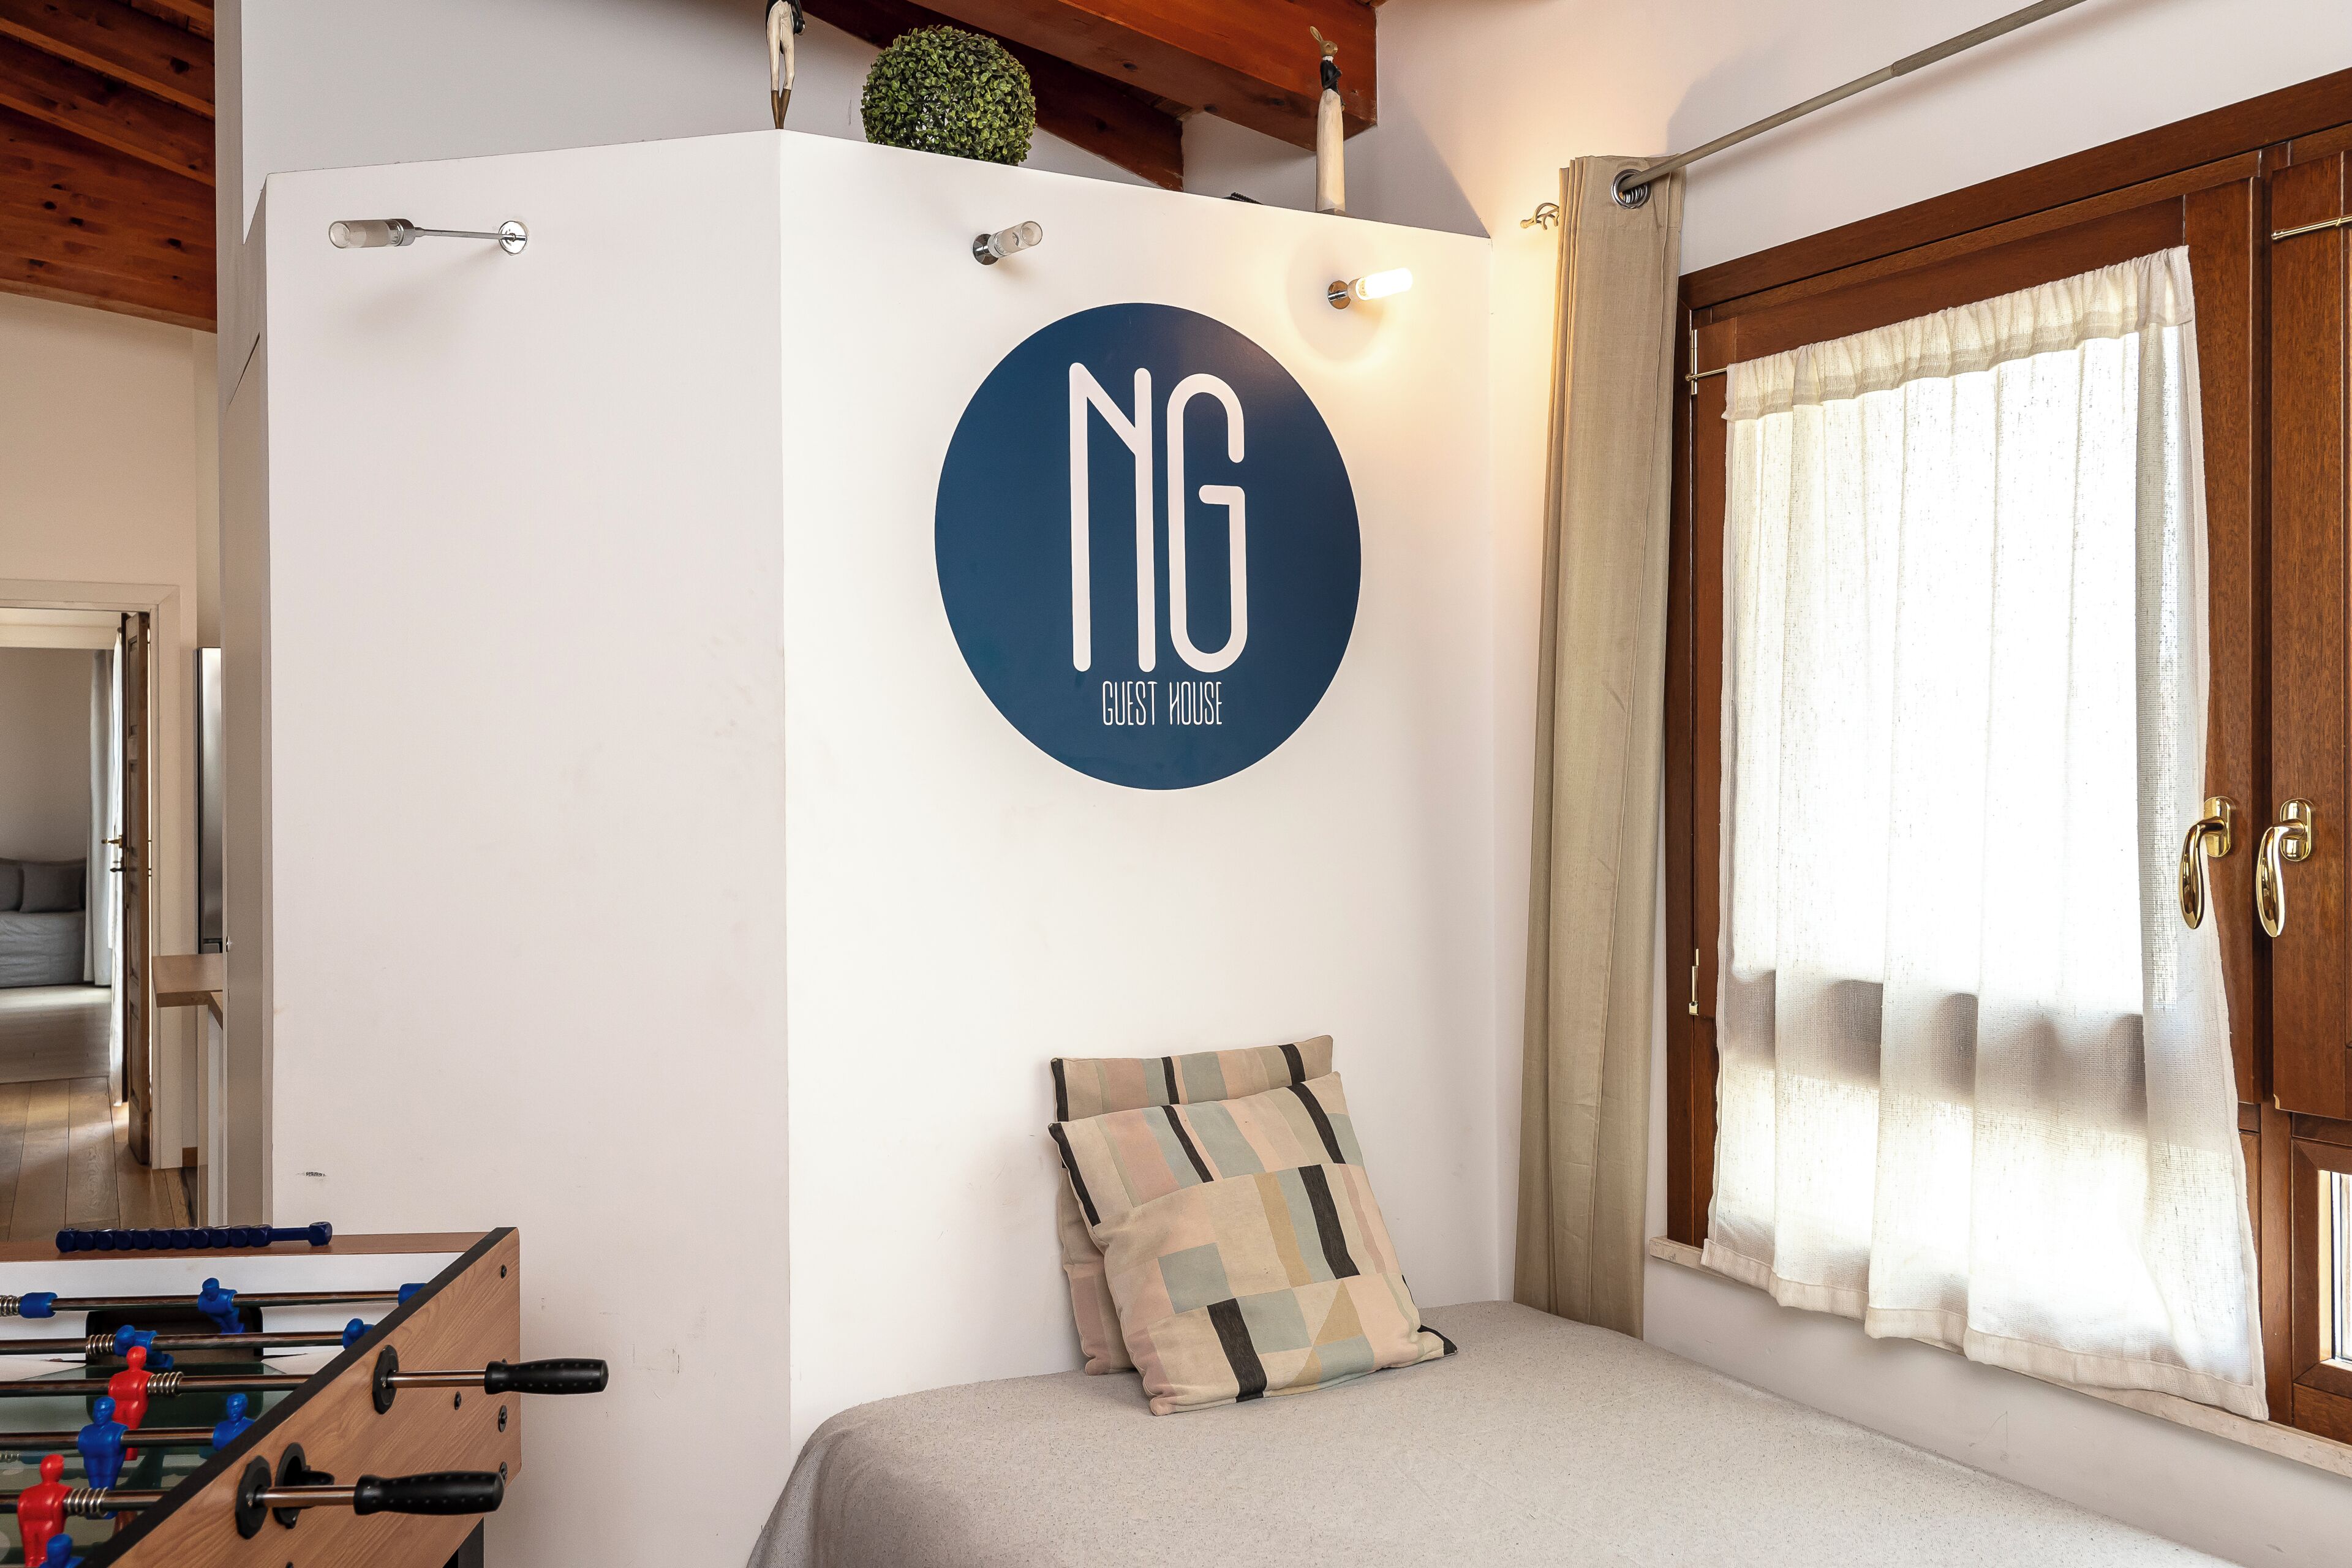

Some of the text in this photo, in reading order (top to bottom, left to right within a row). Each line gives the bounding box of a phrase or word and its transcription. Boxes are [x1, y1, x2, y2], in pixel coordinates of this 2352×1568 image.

[1069, 362, 1248, 673] NG
[1102, 680, 1223, 726] GUEST HOUSE
